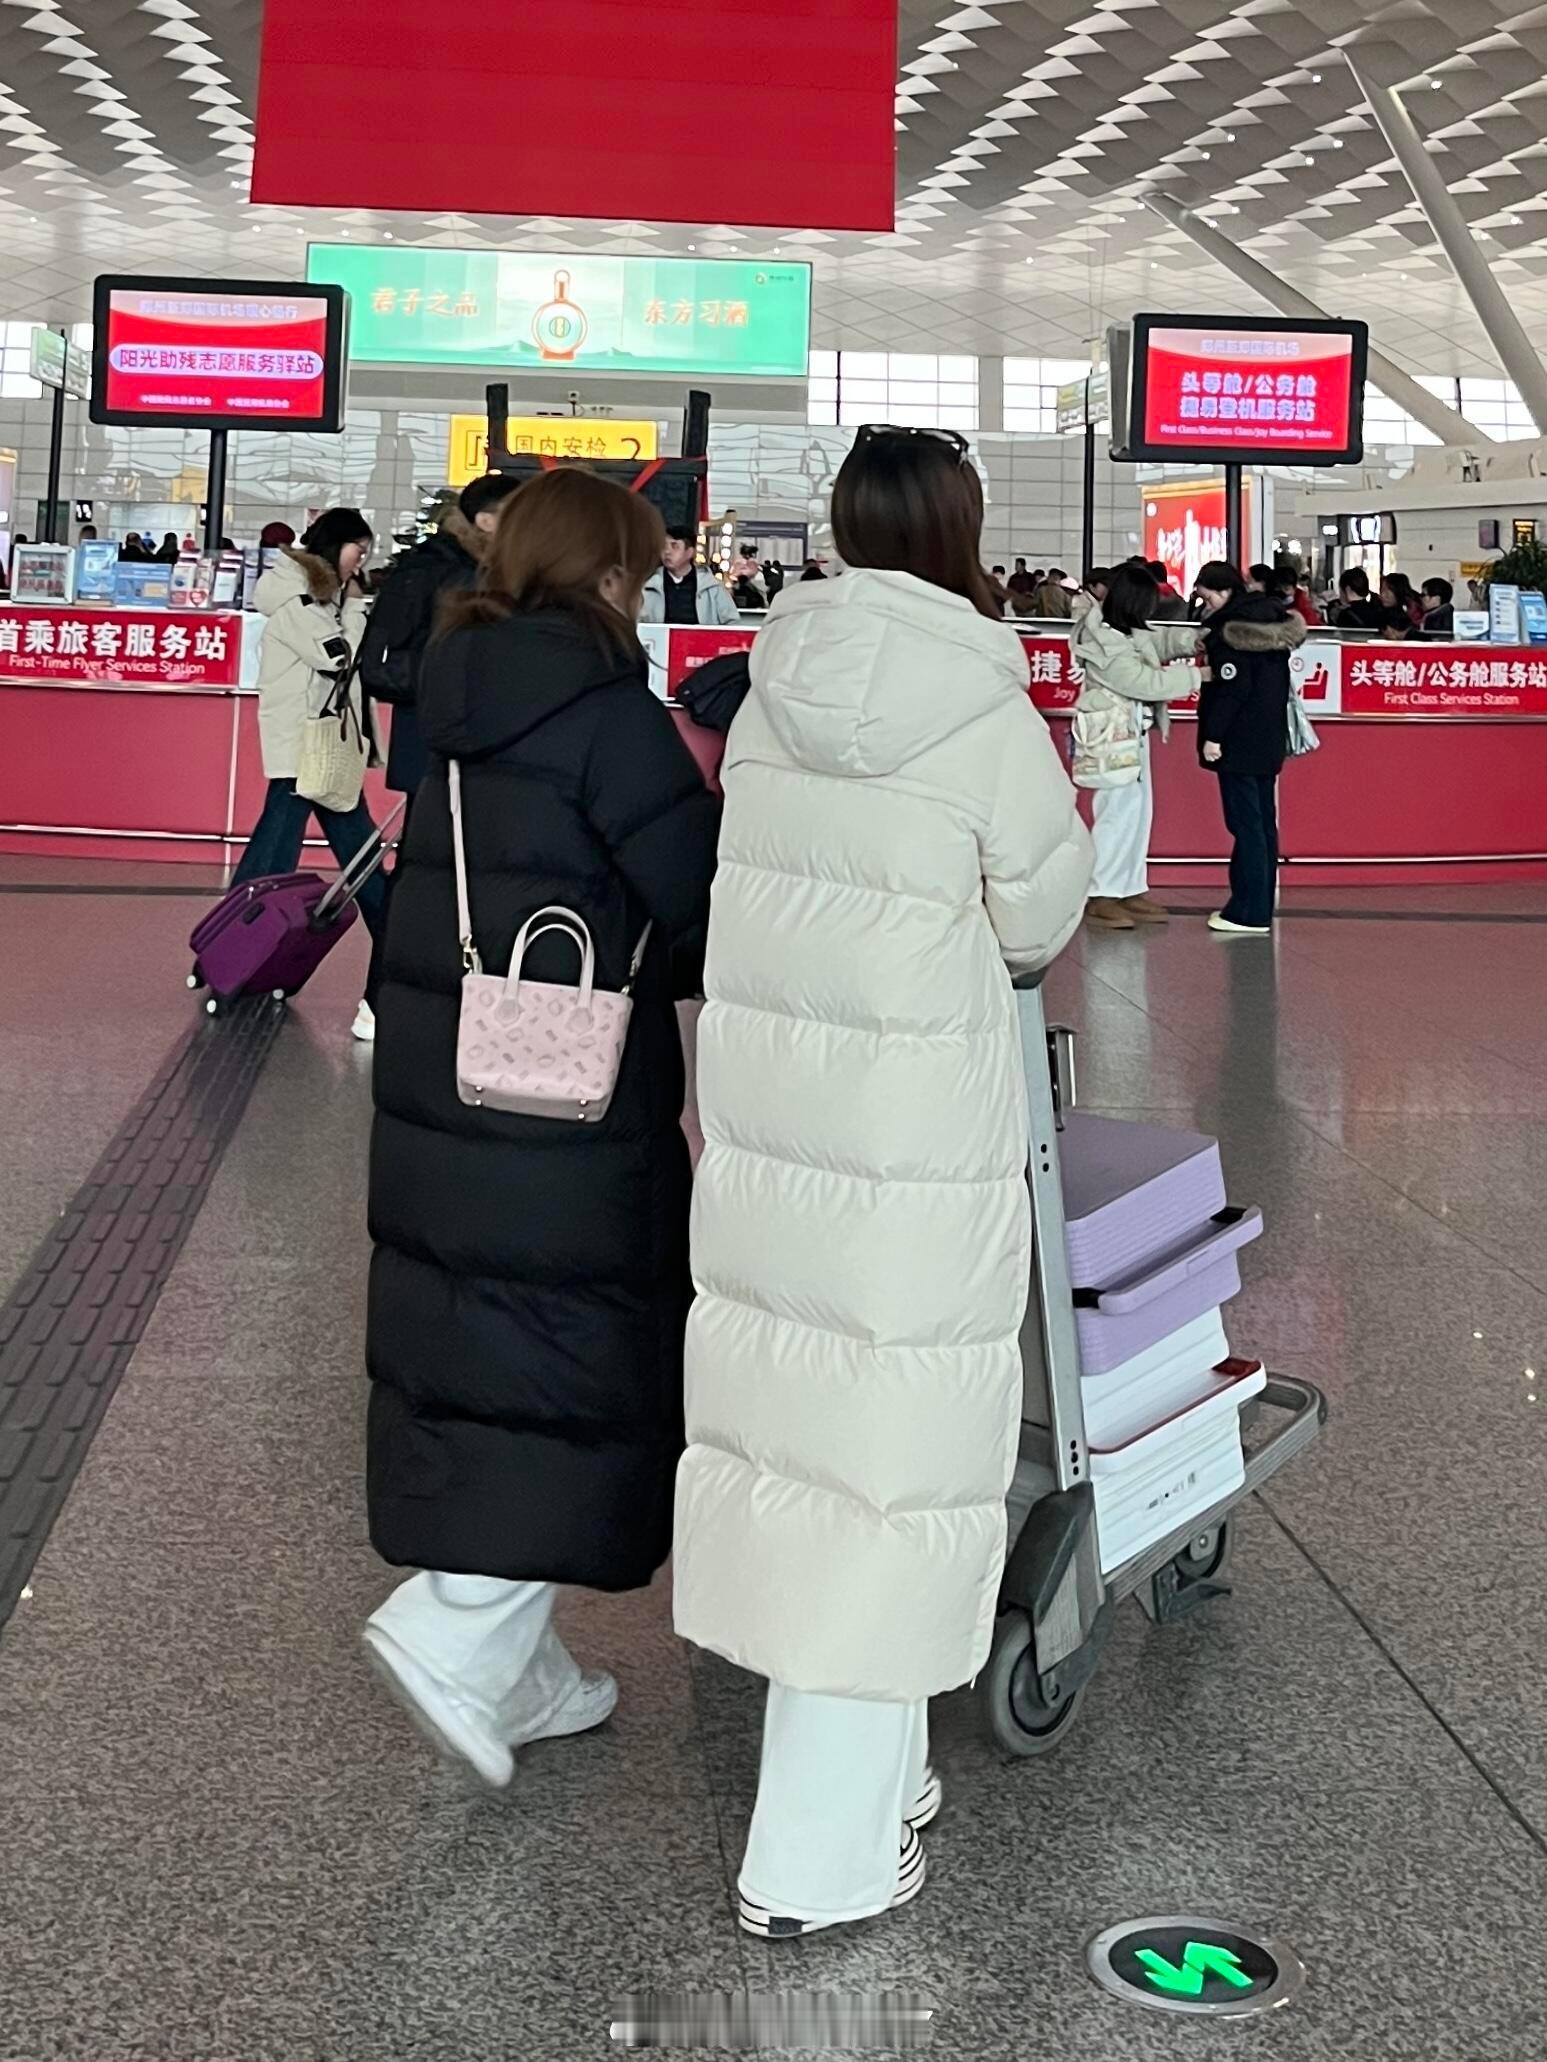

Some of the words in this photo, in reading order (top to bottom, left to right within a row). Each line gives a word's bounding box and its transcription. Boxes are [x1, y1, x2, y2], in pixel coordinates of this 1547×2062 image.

[371, 287, 479, 317] 君子之品
[645, 299, 749, 326] 东方习酒
[120, 349, 315, 374] 阳光助残志愿服务驿站
[1181, 371, 1317, 397] 头等舱/公务舱
[515, 434, 607, 458] 国内安检
[0, 619, 227, 661] 首乘旅客服务站
[9, 656, 70, 670] First-Time
[72, 658, 101, 673] Flyer
[106, 658, 157, 673] Services
[159, 661, 205, 675] Station
[1351, 659, 1547, 688] 头等舱/公务舱服务站
[1053, 687, 1076, 702] Joy
[1384, 691, 1408, 704] First
[1410, 692, 1438, 705] Class
[1440, 692, 1482, 706] Services
[1484, 693, 1520, 706] Station
